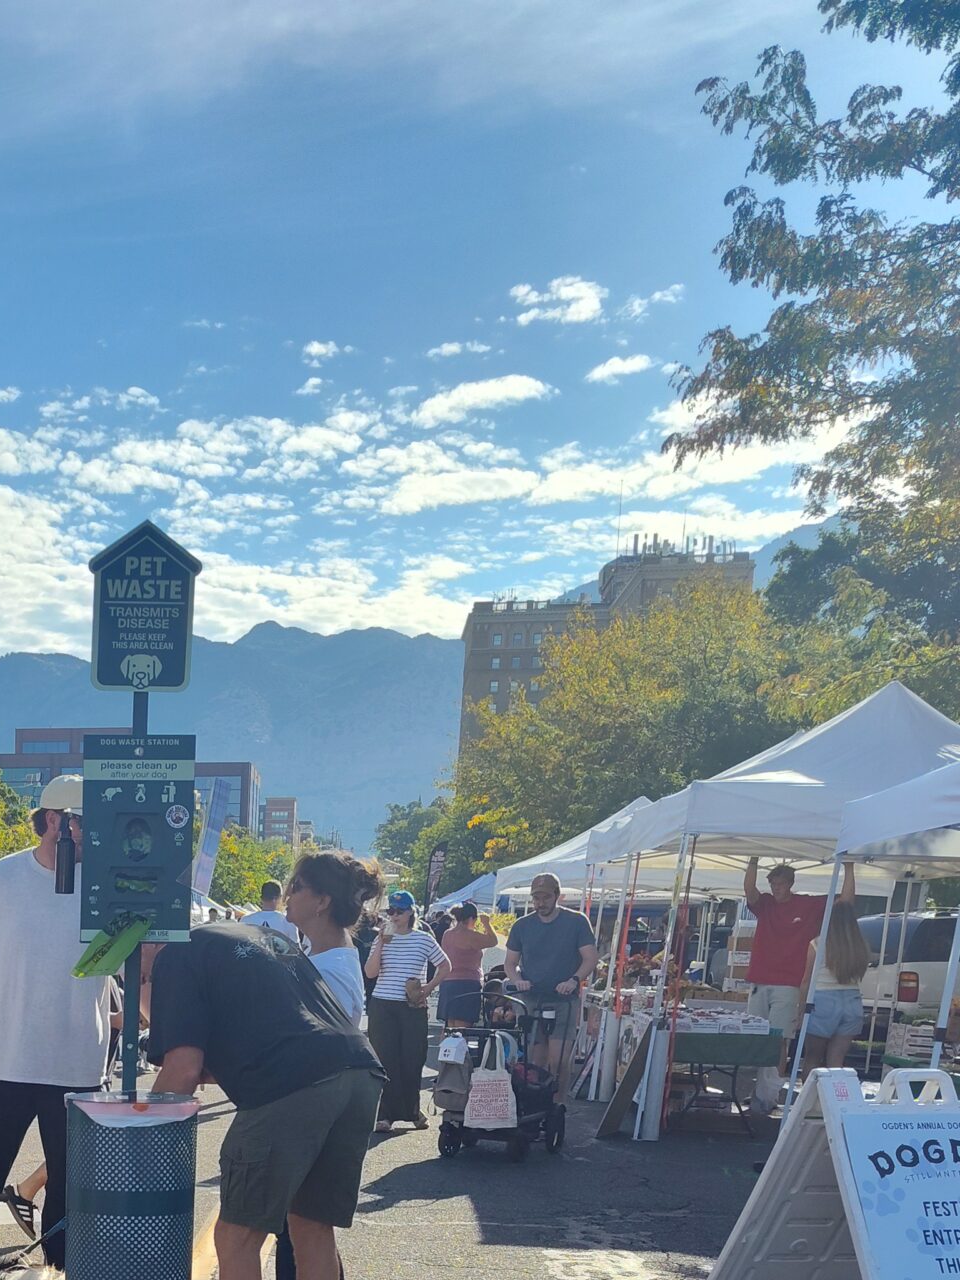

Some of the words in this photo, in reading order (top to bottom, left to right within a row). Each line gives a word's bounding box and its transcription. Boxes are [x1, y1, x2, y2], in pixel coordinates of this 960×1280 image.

[125, 556, 167, 577] PET
[106, 579, 182, 600] WASTE
[109, 606, 180, 618] TRANSMITS
[118, 618, 169, 629] DISEASE
[119, 632, 147, 641] PLEASE
[148, 632, 167, 641] KEEP
[112, 641, 128, 649] THIS
[129, 641, 149, 650] AREA
[150, 641, 174, 650] CLEAN
[100, 738, 117, 746] DOG
[119, 738, 145, 746] WASTE
[147, 738, 180, 746] STATION
[100, 761, 133, 772] please
[135, 761, 162, 770] clean
[165, 762, 178, 772] up
[131, 771, 150, 779] your
[151, 771, 168, 779] dog
[881, 1122, 914, 1130] OGDEN'S
[917, 1121, 946, 1130] ANNUAL
[922, 1200, 960, 1217] FEST
